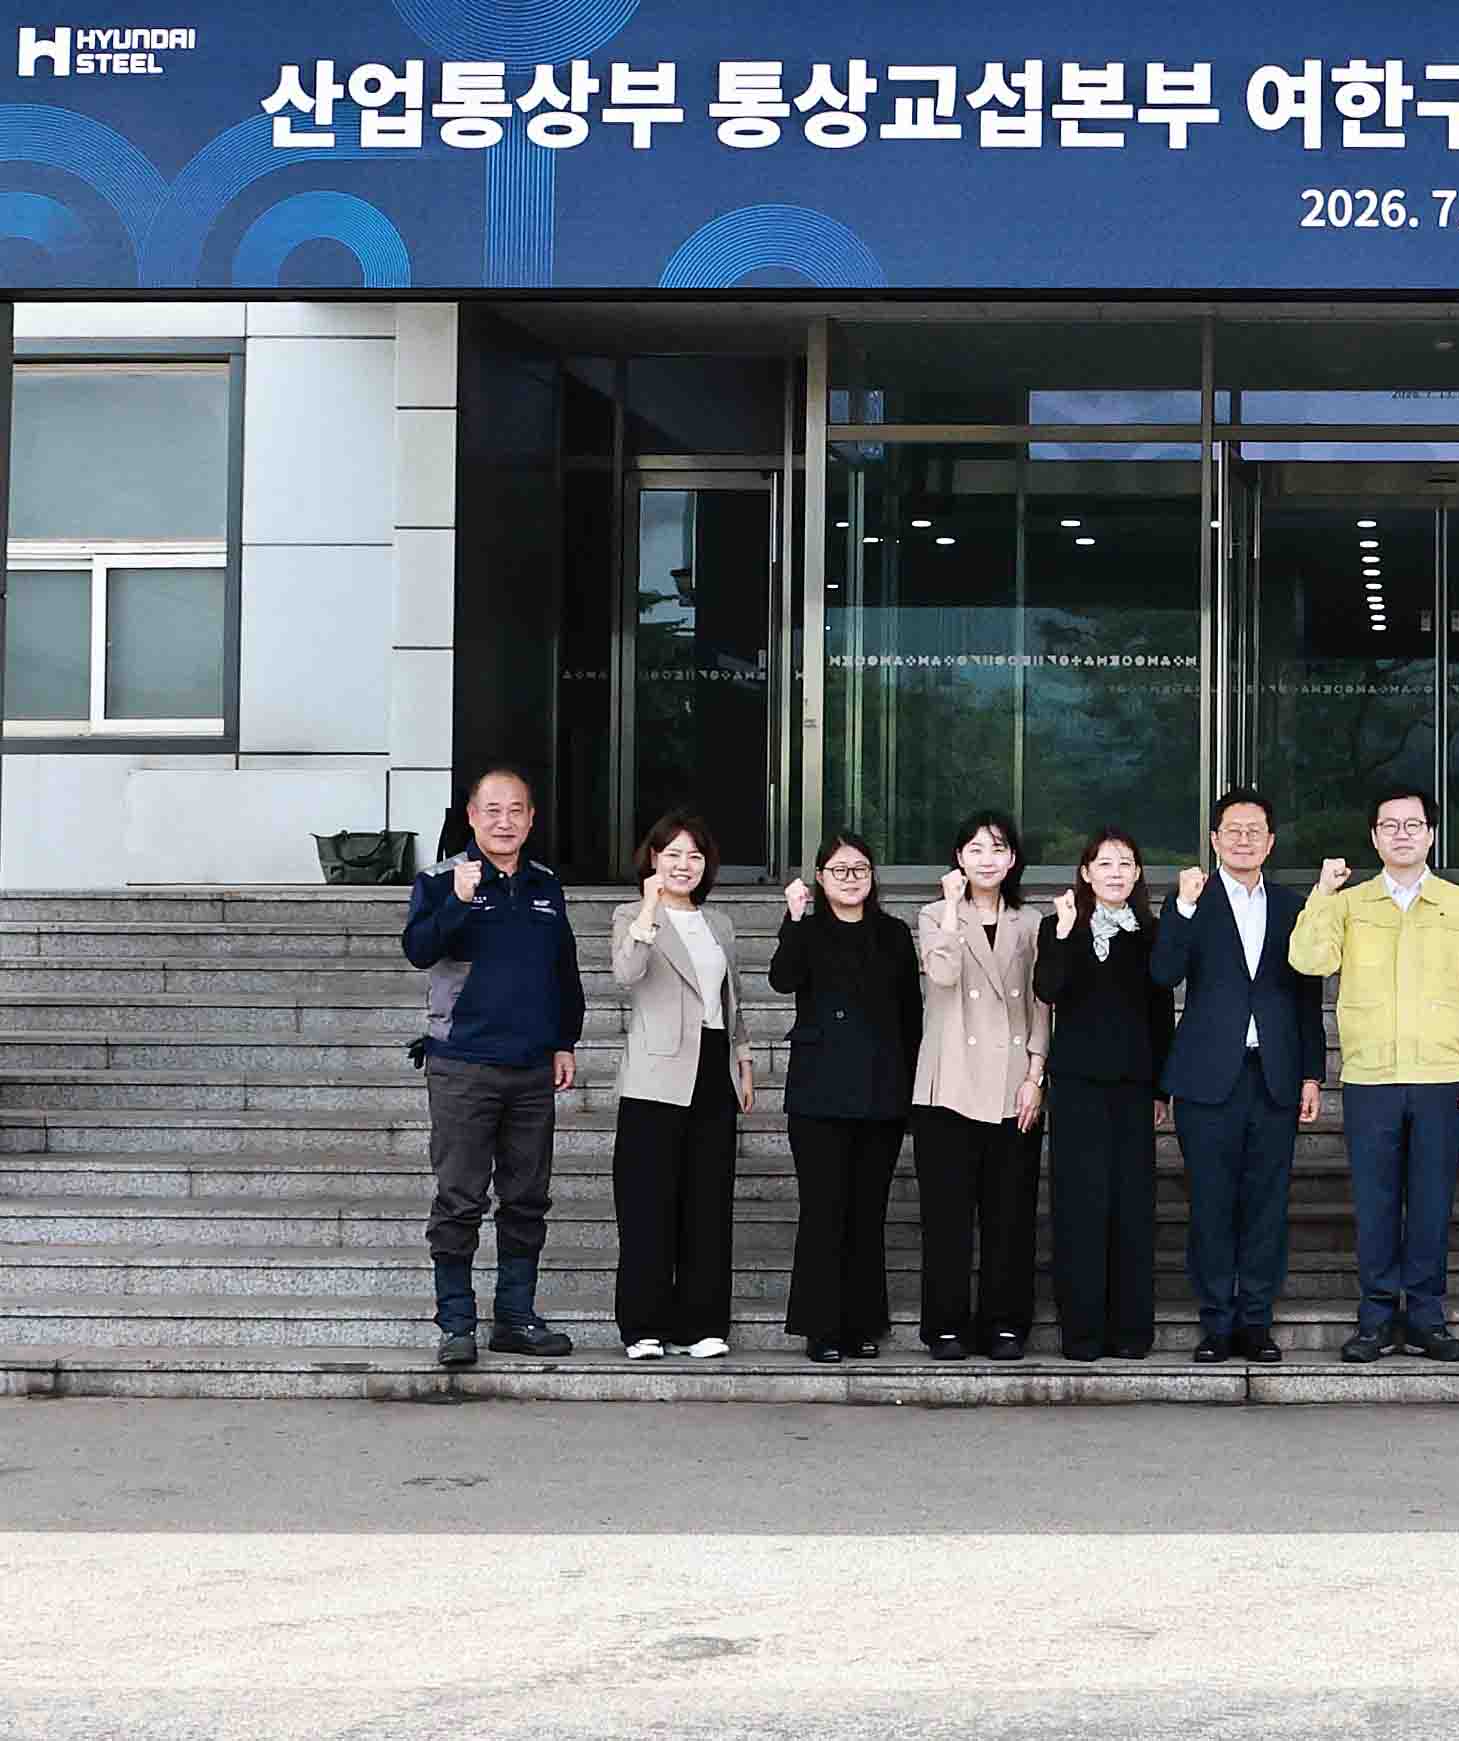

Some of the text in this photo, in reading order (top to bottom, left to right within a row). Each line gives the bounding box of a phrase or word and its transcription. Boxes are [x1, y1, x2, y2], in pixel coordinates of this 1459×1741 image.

[76, 28, 196, 50] HYUNDAI
[76, 53, 163, 74] STEEL
[261, 59, 684, 149] 산업통상부
[709, 59, 1220, 149] 통상교섭본부
[1300, 189, 1419, 228] 2026.
